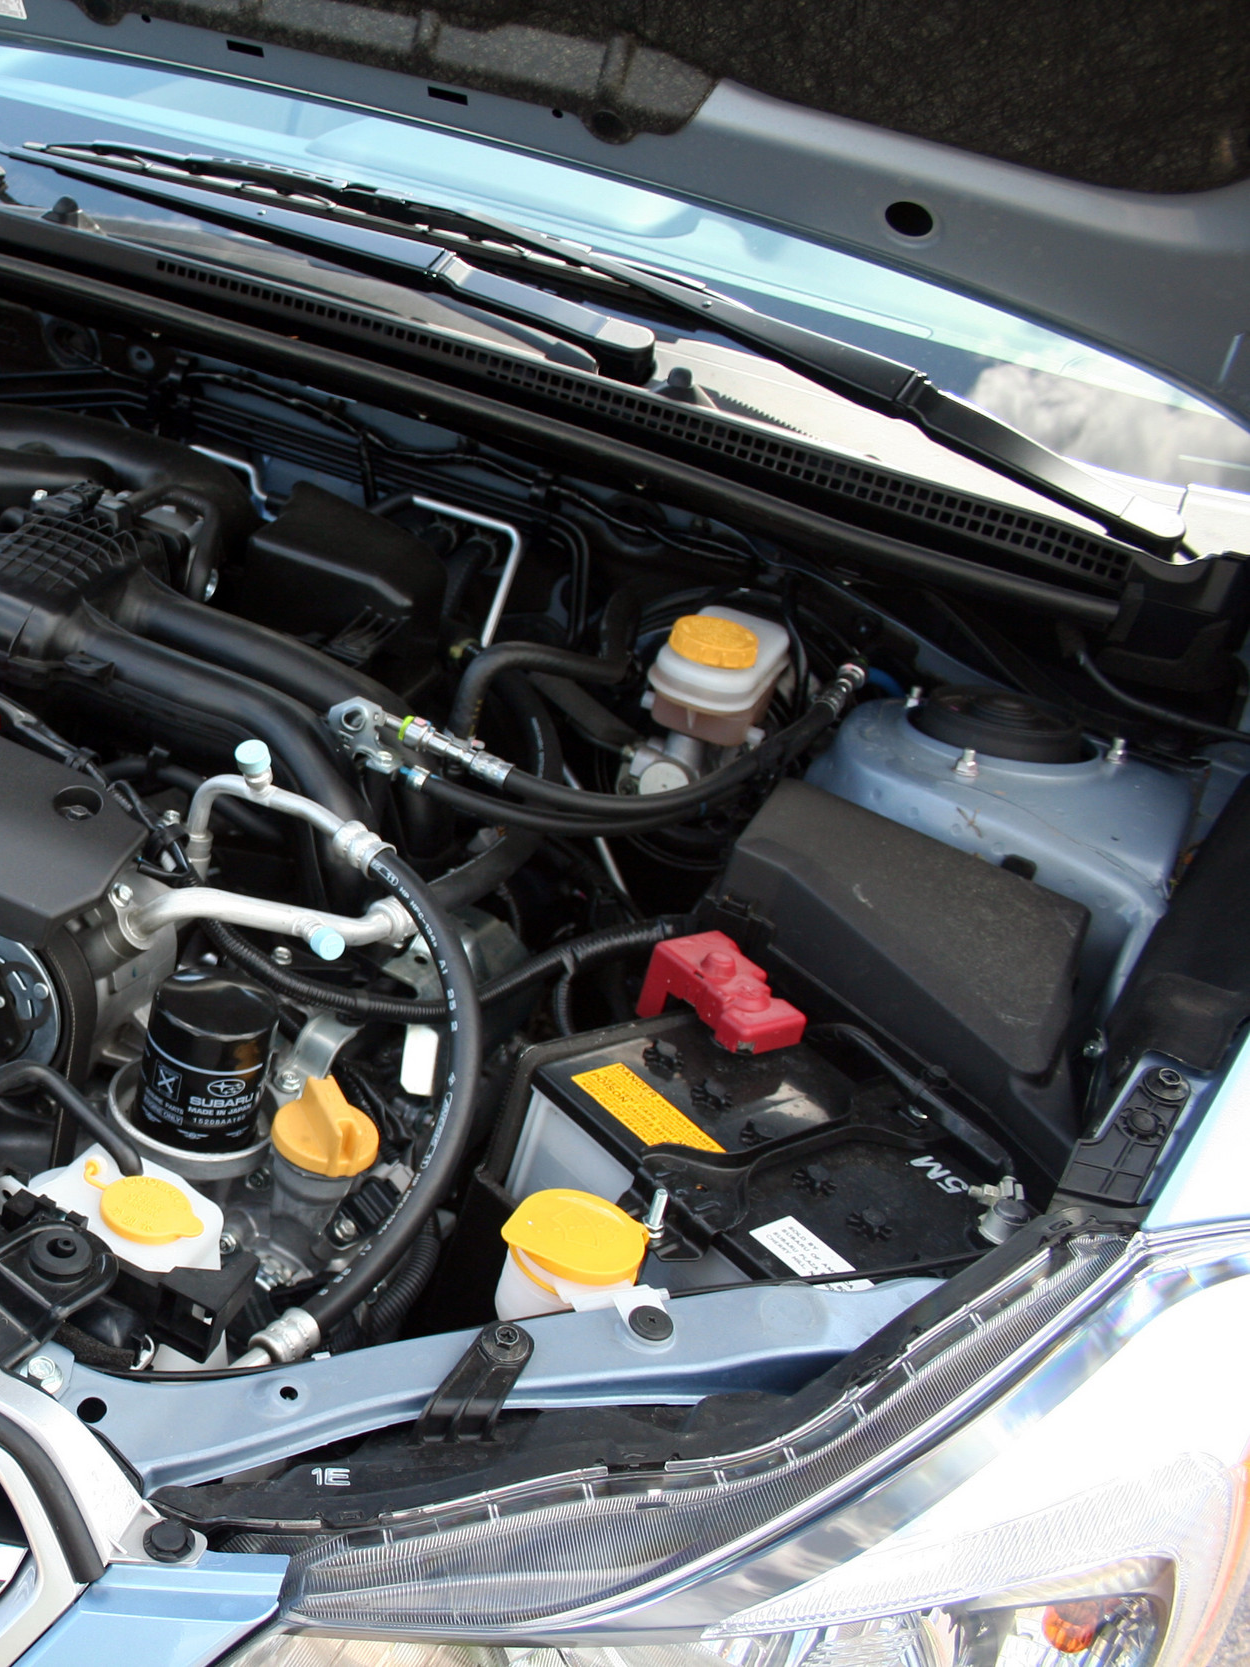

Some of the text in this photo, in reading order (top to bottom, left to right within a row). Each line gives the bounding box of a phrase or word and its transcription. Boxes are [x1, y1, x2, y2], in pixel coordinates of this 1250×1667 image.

[589, 1072, 629, 1102] POISON
[614, 1064, 659, 1098] DANGER
[165, 1101, 184, 1115] PARTS
[187, 1103, 252, 1116] MADE IN JAPAN
[189, 1092, 254, 1108] SUBARU
[909, 1155, 969, 1194] 5M
[764, 1233, 791, 1254] CHERRY
[780, 1228, 811, 1251] SUBARU
[809, 1252, 821, 1260] OF
[788, 1226, 819, 1250] SOLD BY
[774, 1232, 798, 1252] SUBARU
[800, 1254, 819, 1270] PLAZA
[311, 1467, 351, 1486] 1E
